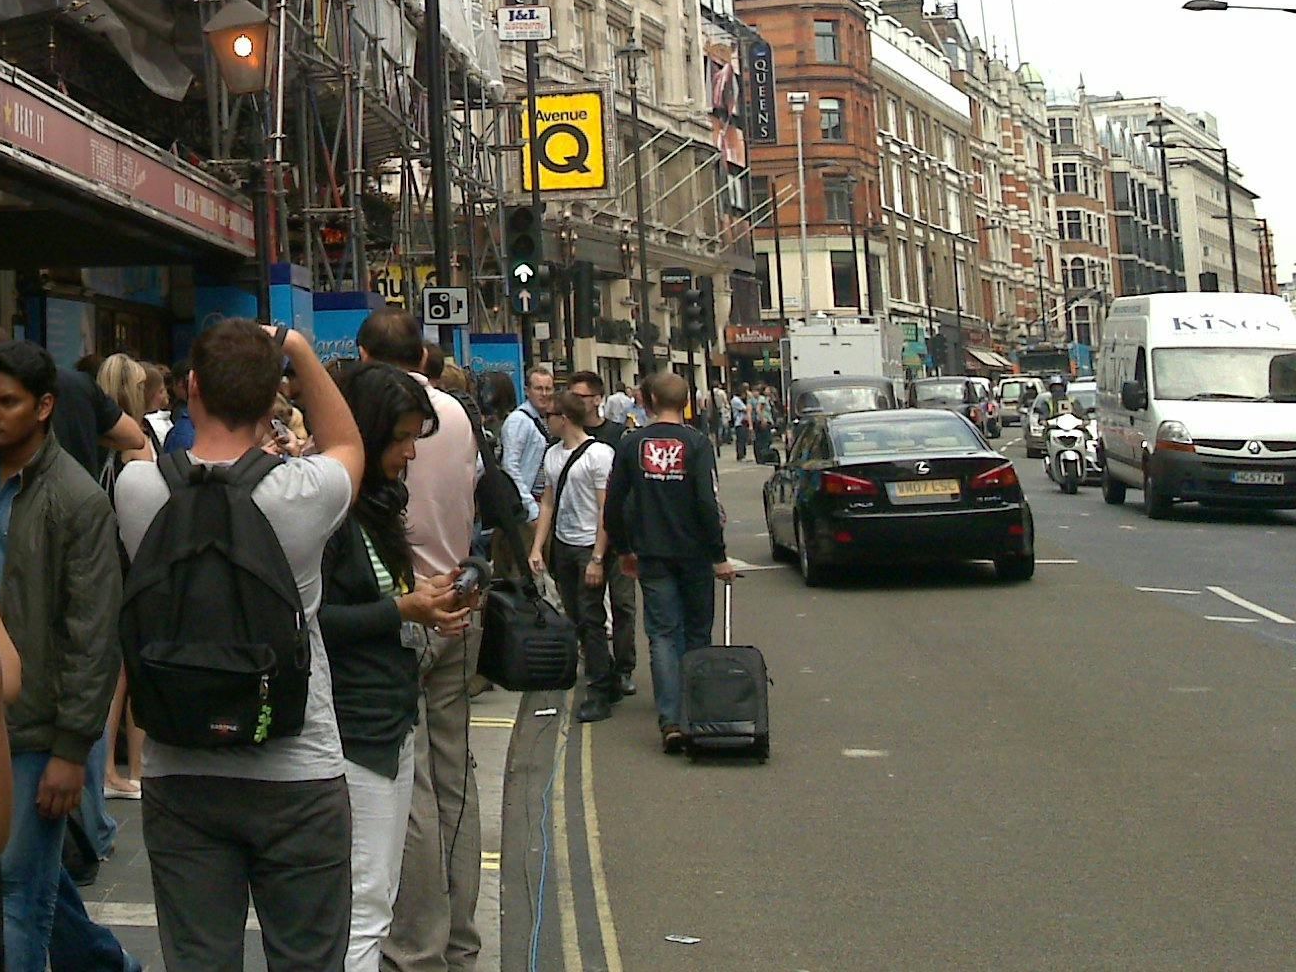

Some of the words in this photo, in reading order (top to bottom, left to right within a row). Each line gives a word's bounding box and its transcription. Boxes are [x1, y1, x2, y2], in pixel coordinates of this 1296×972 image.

[535, 110, 588, 122] Avenue
[754, 59, 770, 138] QUEENS
[37, 114, 45, 145] IT
[536, 123, 591, 174] Q
